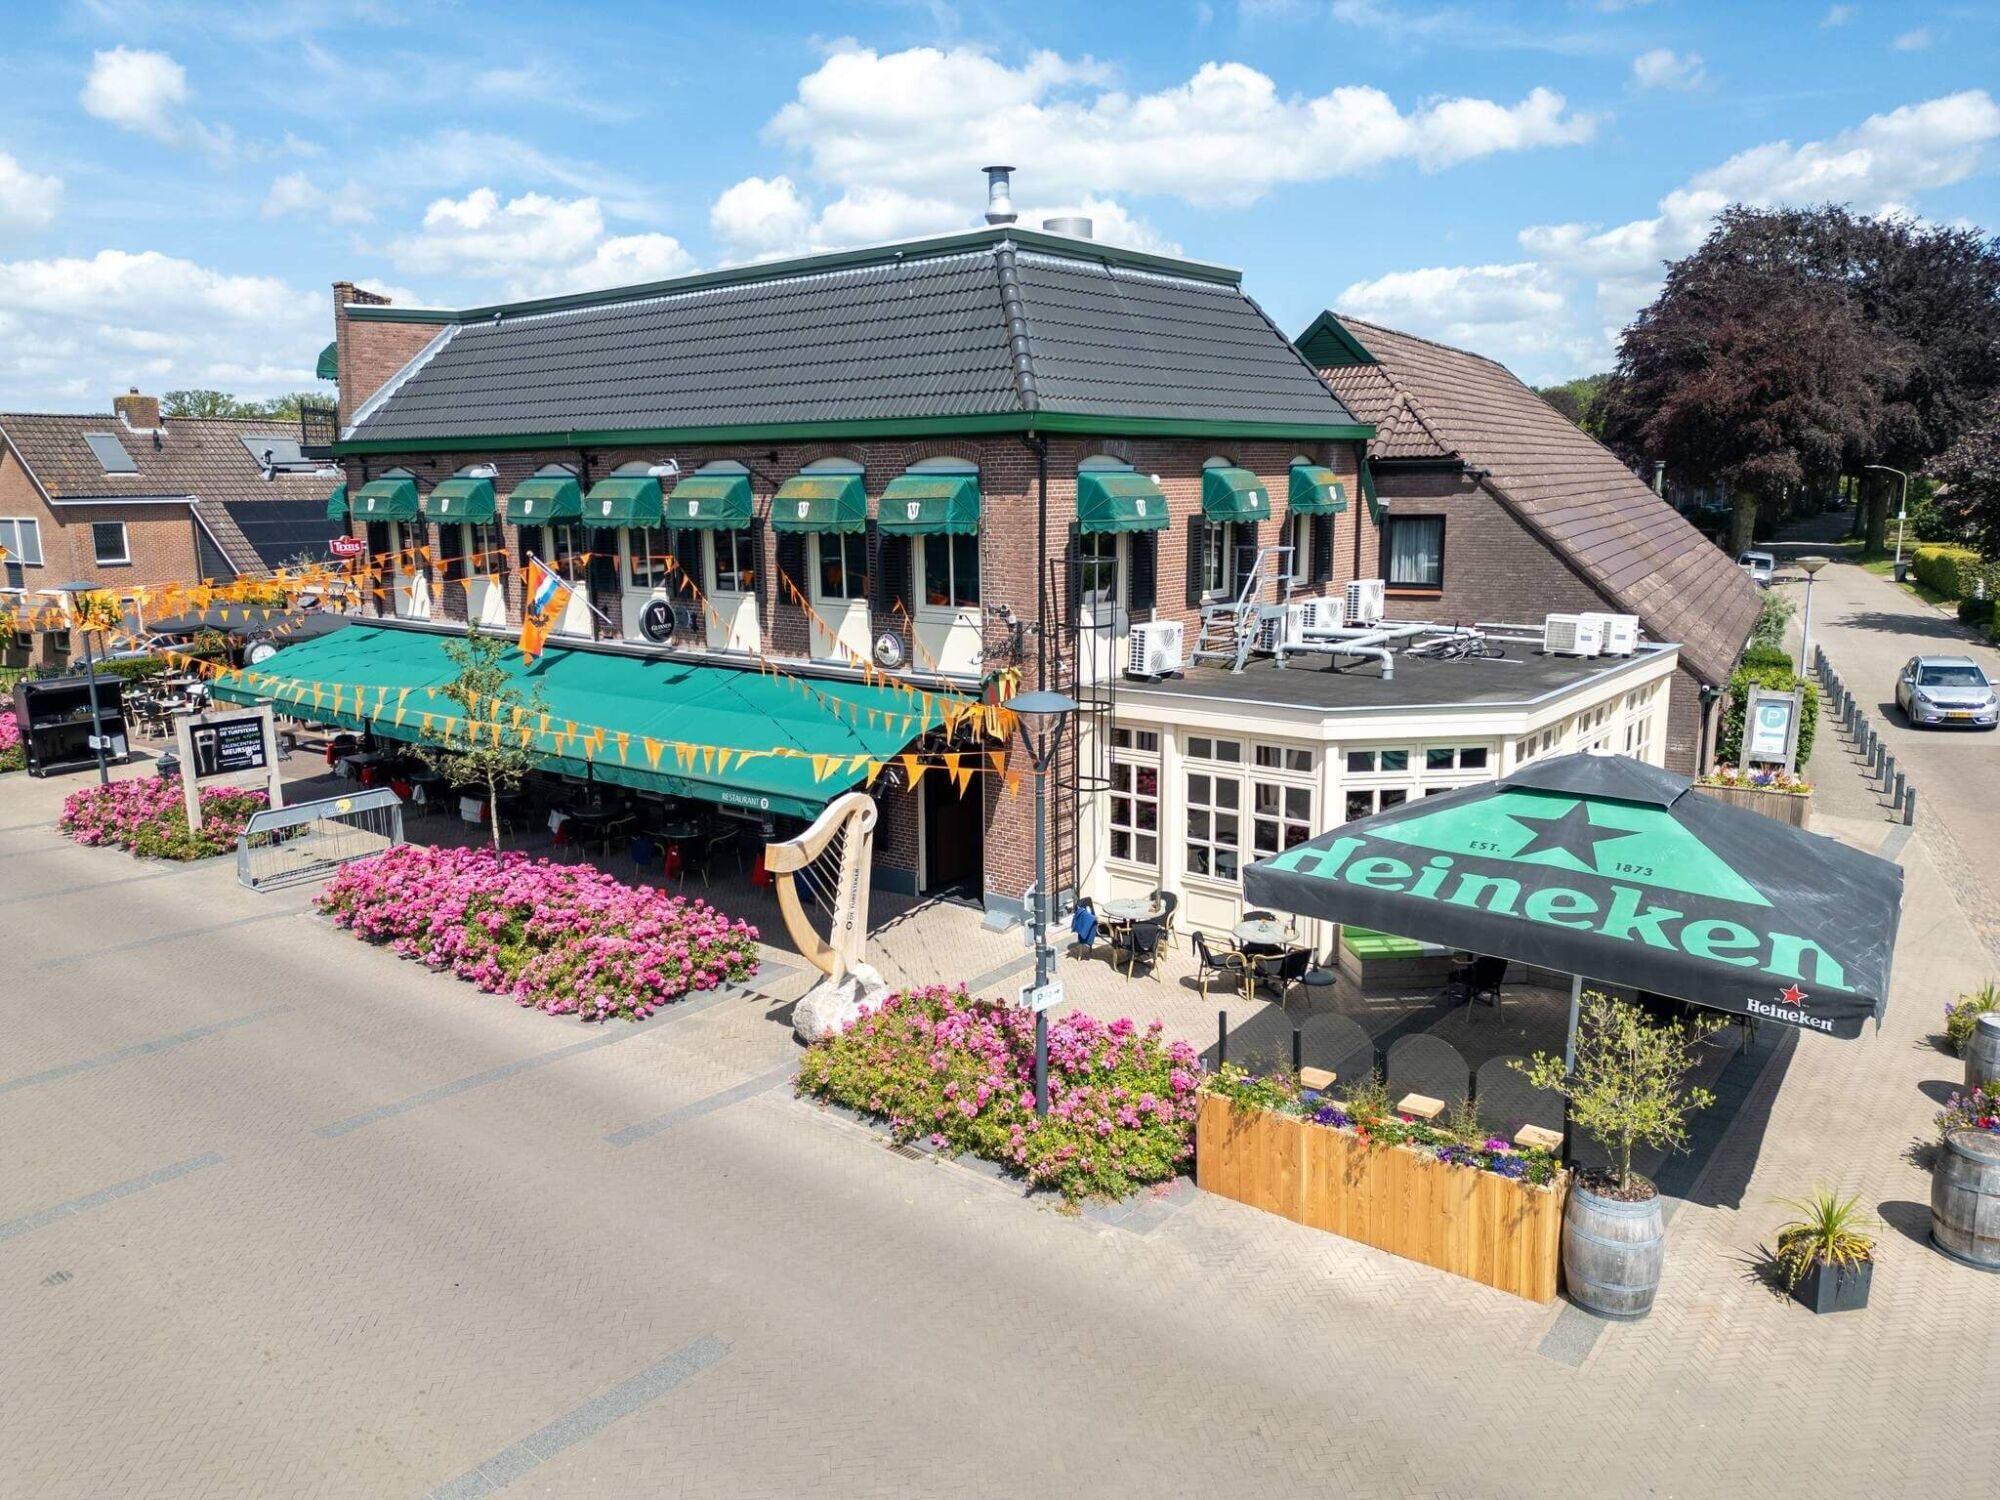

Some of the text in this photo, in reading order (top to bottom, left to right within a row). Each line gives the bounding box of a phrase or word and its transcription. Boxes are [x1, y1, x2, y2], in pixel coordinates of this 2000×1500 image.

[1766, 710, 1780, 724] P
[721, 792, 760, 806] RESTAURANT
[1469, 840, 1501, 852] EST.
[1614, 862, 1655, 877] 1873
[1262, 836, 1857, 993] Heineken
[1746, 998, 1833, 1032] Heineken
